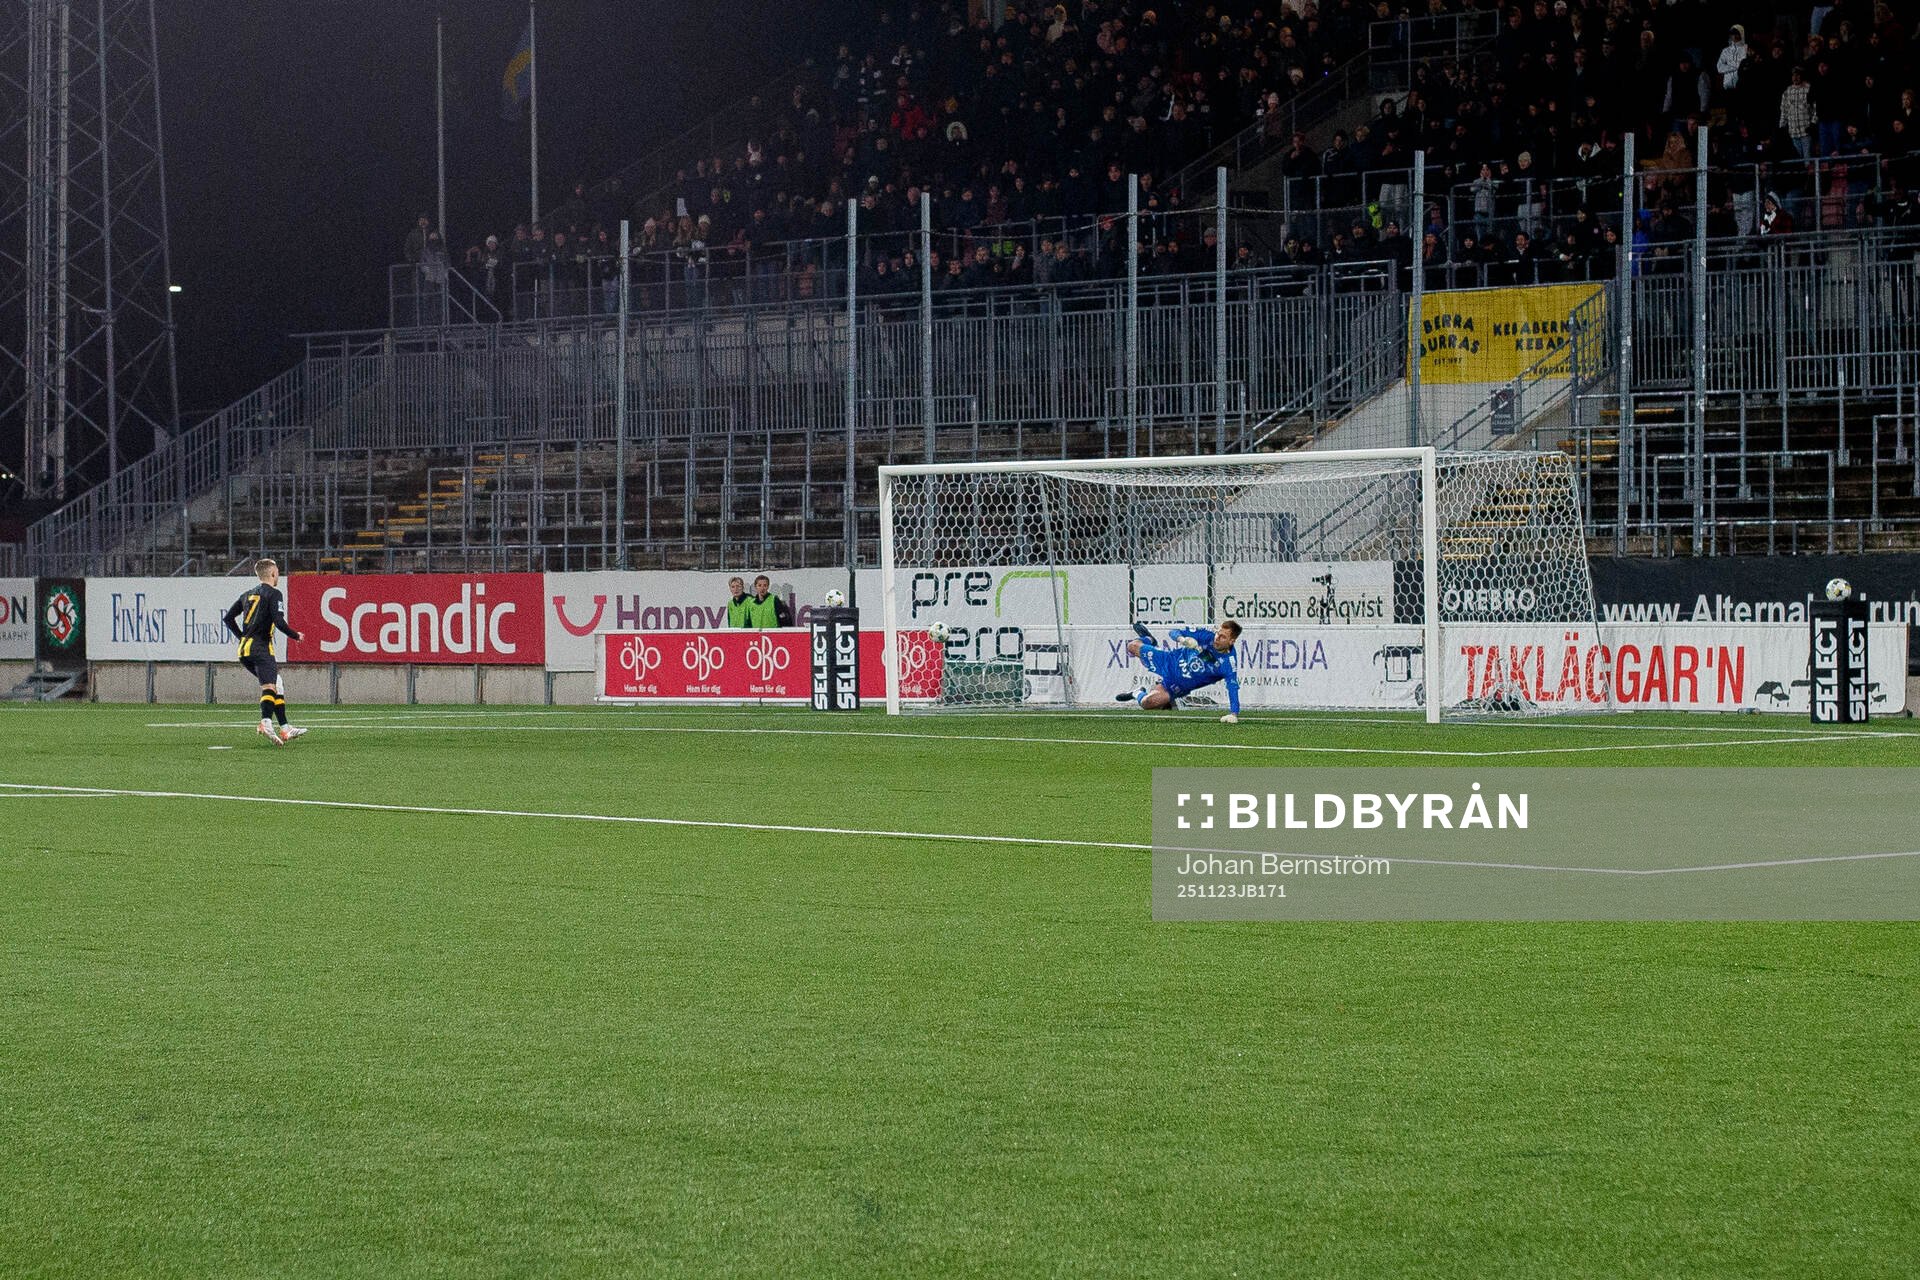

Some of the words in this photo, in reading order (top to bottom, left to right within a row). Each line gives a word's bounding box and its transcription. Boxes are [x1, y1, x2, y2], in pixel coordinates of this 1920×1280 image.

[1493, 320, 1588, 336] KEBABERN
[247, 594, 261, 624] 7
[616, 594, 727, 630] Happy
[912, 571, 993, 618] pre
[1222, 592, 1301, 619] Carlsson
[1444, 583, 1535, 612] ÖREBRO
[320, 582, 516, 654] Scandic
[620, 636, 662, 681] ÖBO
[682, 636, 725, 681] ÖBO
[746, 635, 790, 681] ÖBO
[813, 622, 828, 710] SELECT
[836, 622, 856, 710] SELECT
[881, 633, 926, 680] BO
[943, 626, 1024, 661] ero
[1461, 631, 1745, 704] TAKLÄGGAR'N
[1815, 617, 1838, 722] SELECT
[1848, 617, 1866, 722] SELECT
